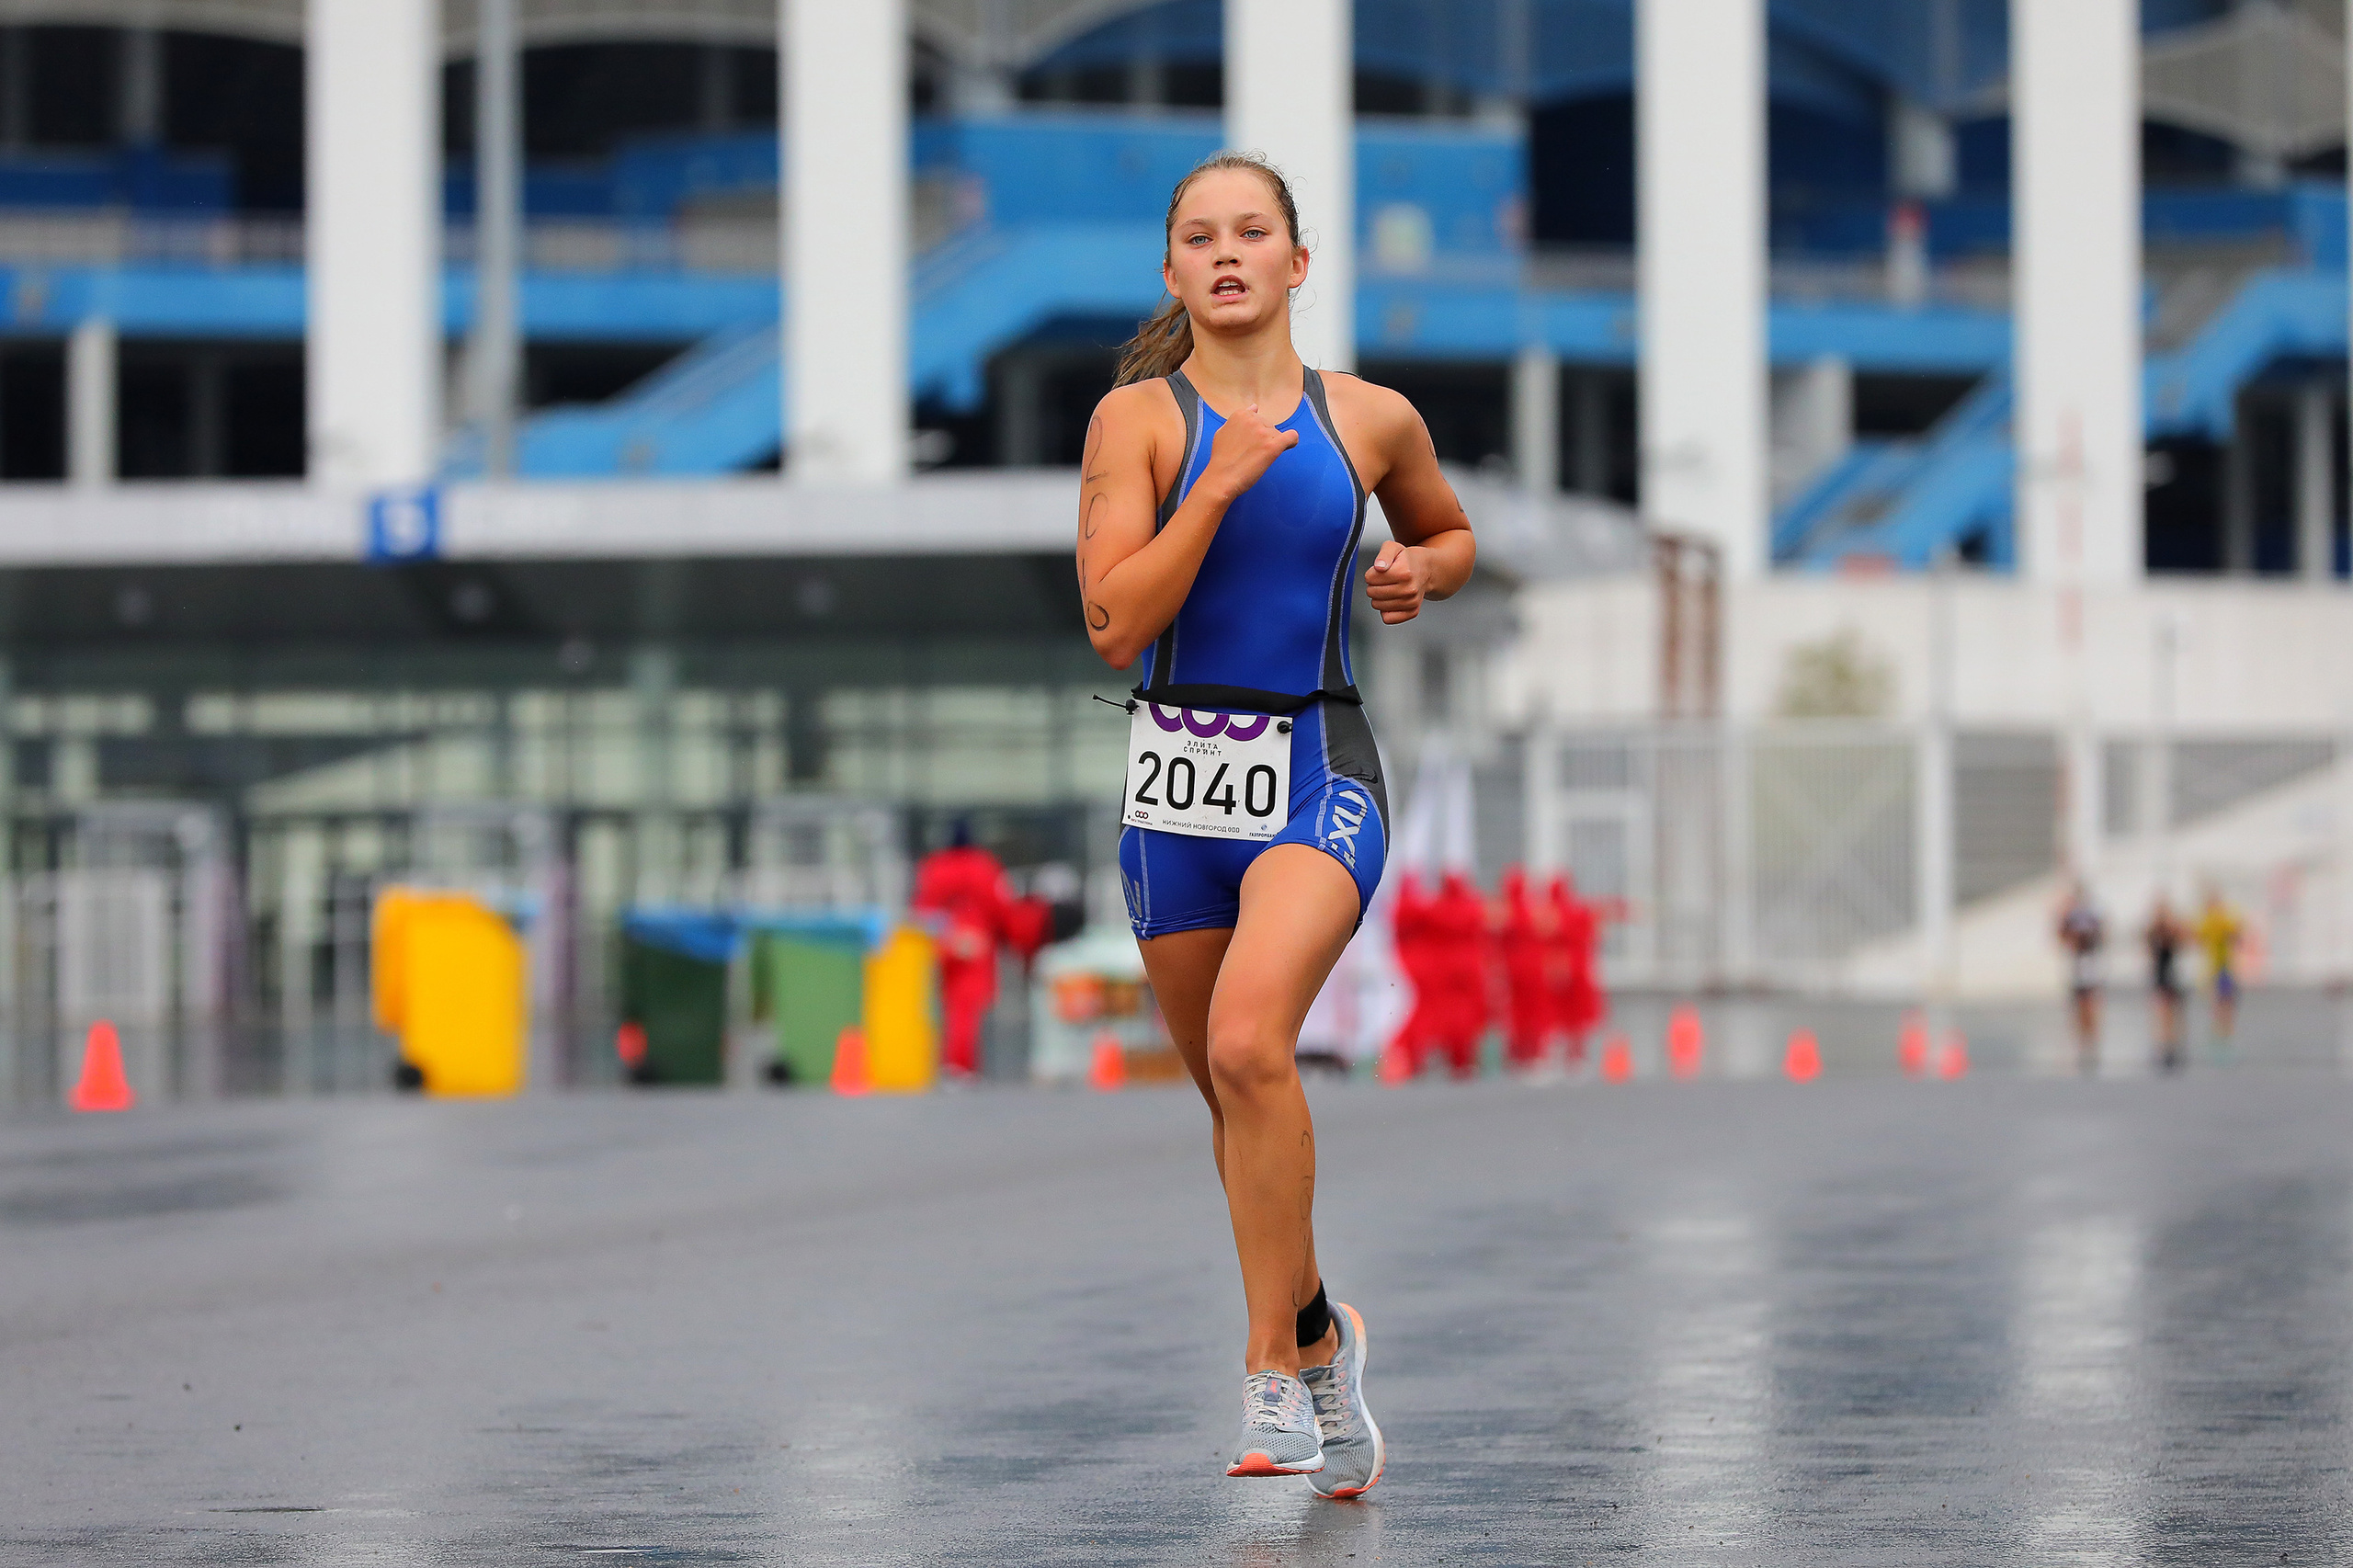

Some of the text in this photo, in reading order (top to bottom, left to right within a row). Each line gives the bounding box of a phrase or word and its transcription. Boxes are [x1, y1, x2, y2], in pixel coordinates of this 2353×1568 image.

[1183, 745, 1222, 756] СПРИНТ
[1187, 740, 1219, 750] ЭЛИТА
[1134, 750, 1277, 818] 2040
[1162, 819, 1192, 829] НИЖНИЙ
[1192, 824, 1227, 833] НОВГОРОД
